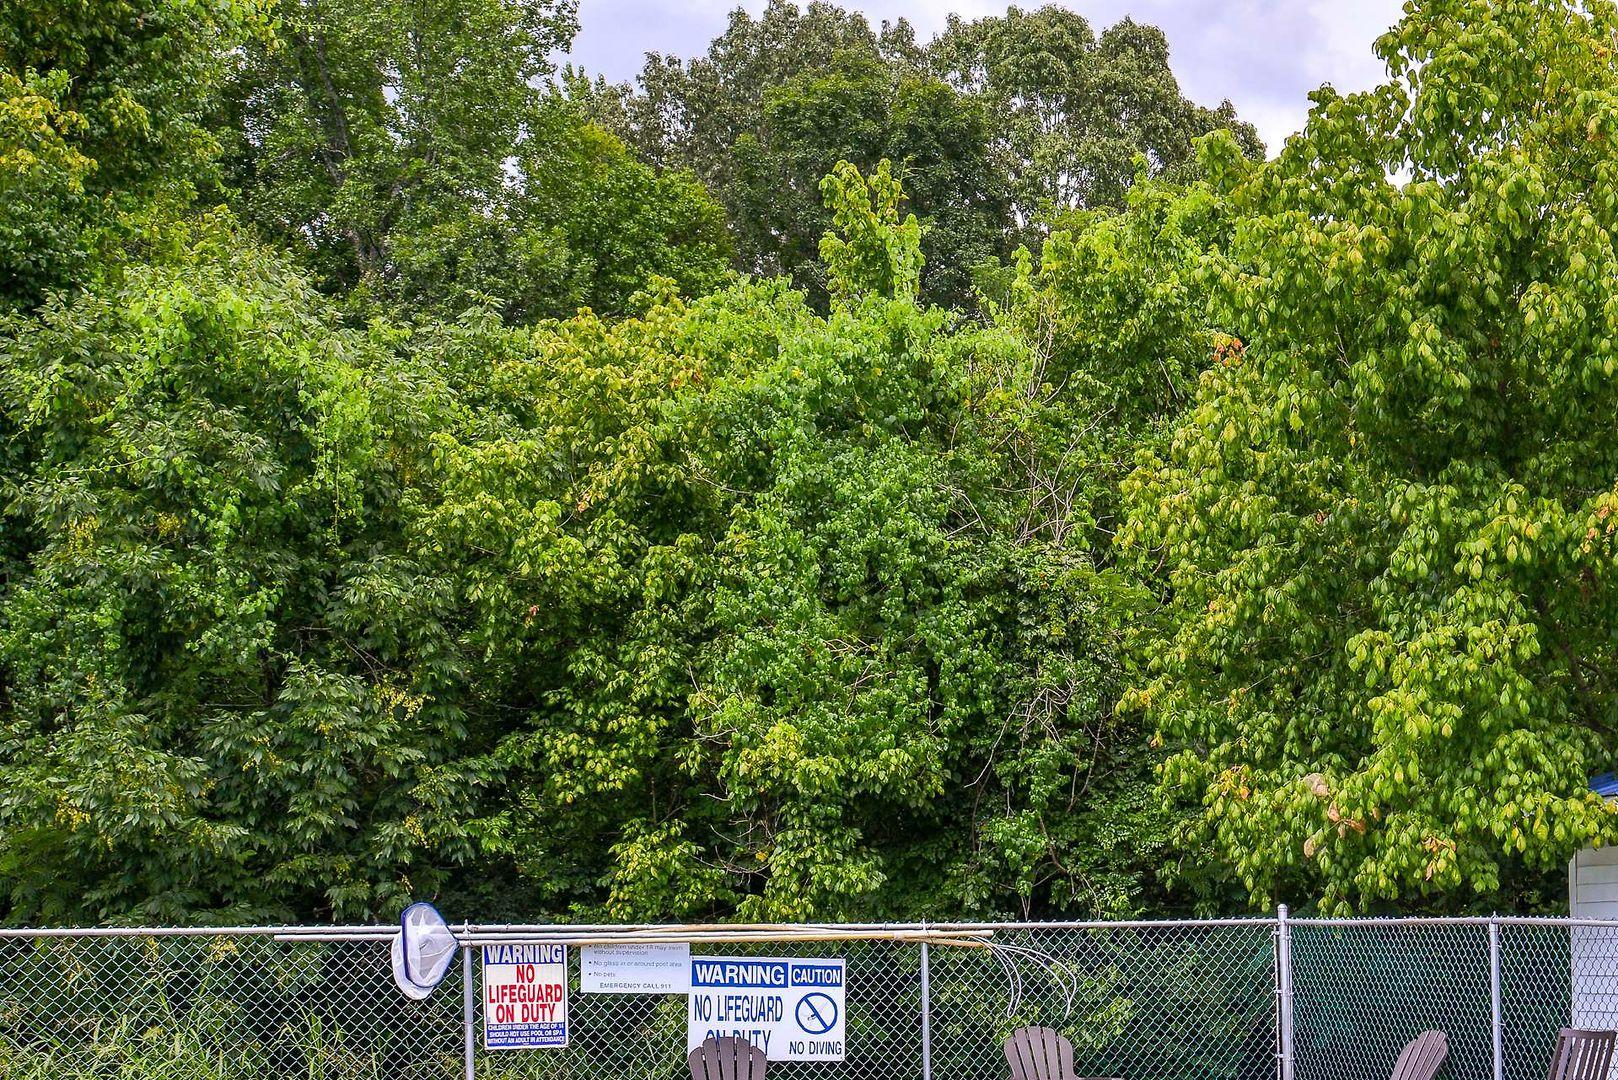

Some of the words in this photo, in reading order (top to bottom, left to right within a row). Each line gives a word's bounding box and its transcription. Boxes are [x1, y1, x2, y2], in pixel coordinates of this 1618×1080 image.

[486, 944, 563, 964] WARNING
[516, 964, 535, 984] NO
[695, 963, 785, 985] WARNING
[792, 968, 841, 984] CAUTION
[488, 984, 562, 1003] LIFEGUARD
[495, 1004, 515, 1024] ON
[521, 1003, 556, 1023] DUTY
[694, 994, 712, 1022] NO
[717, 994, 783, 1023] LIFEGUARD
[789, 1040, 805, 1055] NO
[808, 1041, 842, 1056] DIVING
